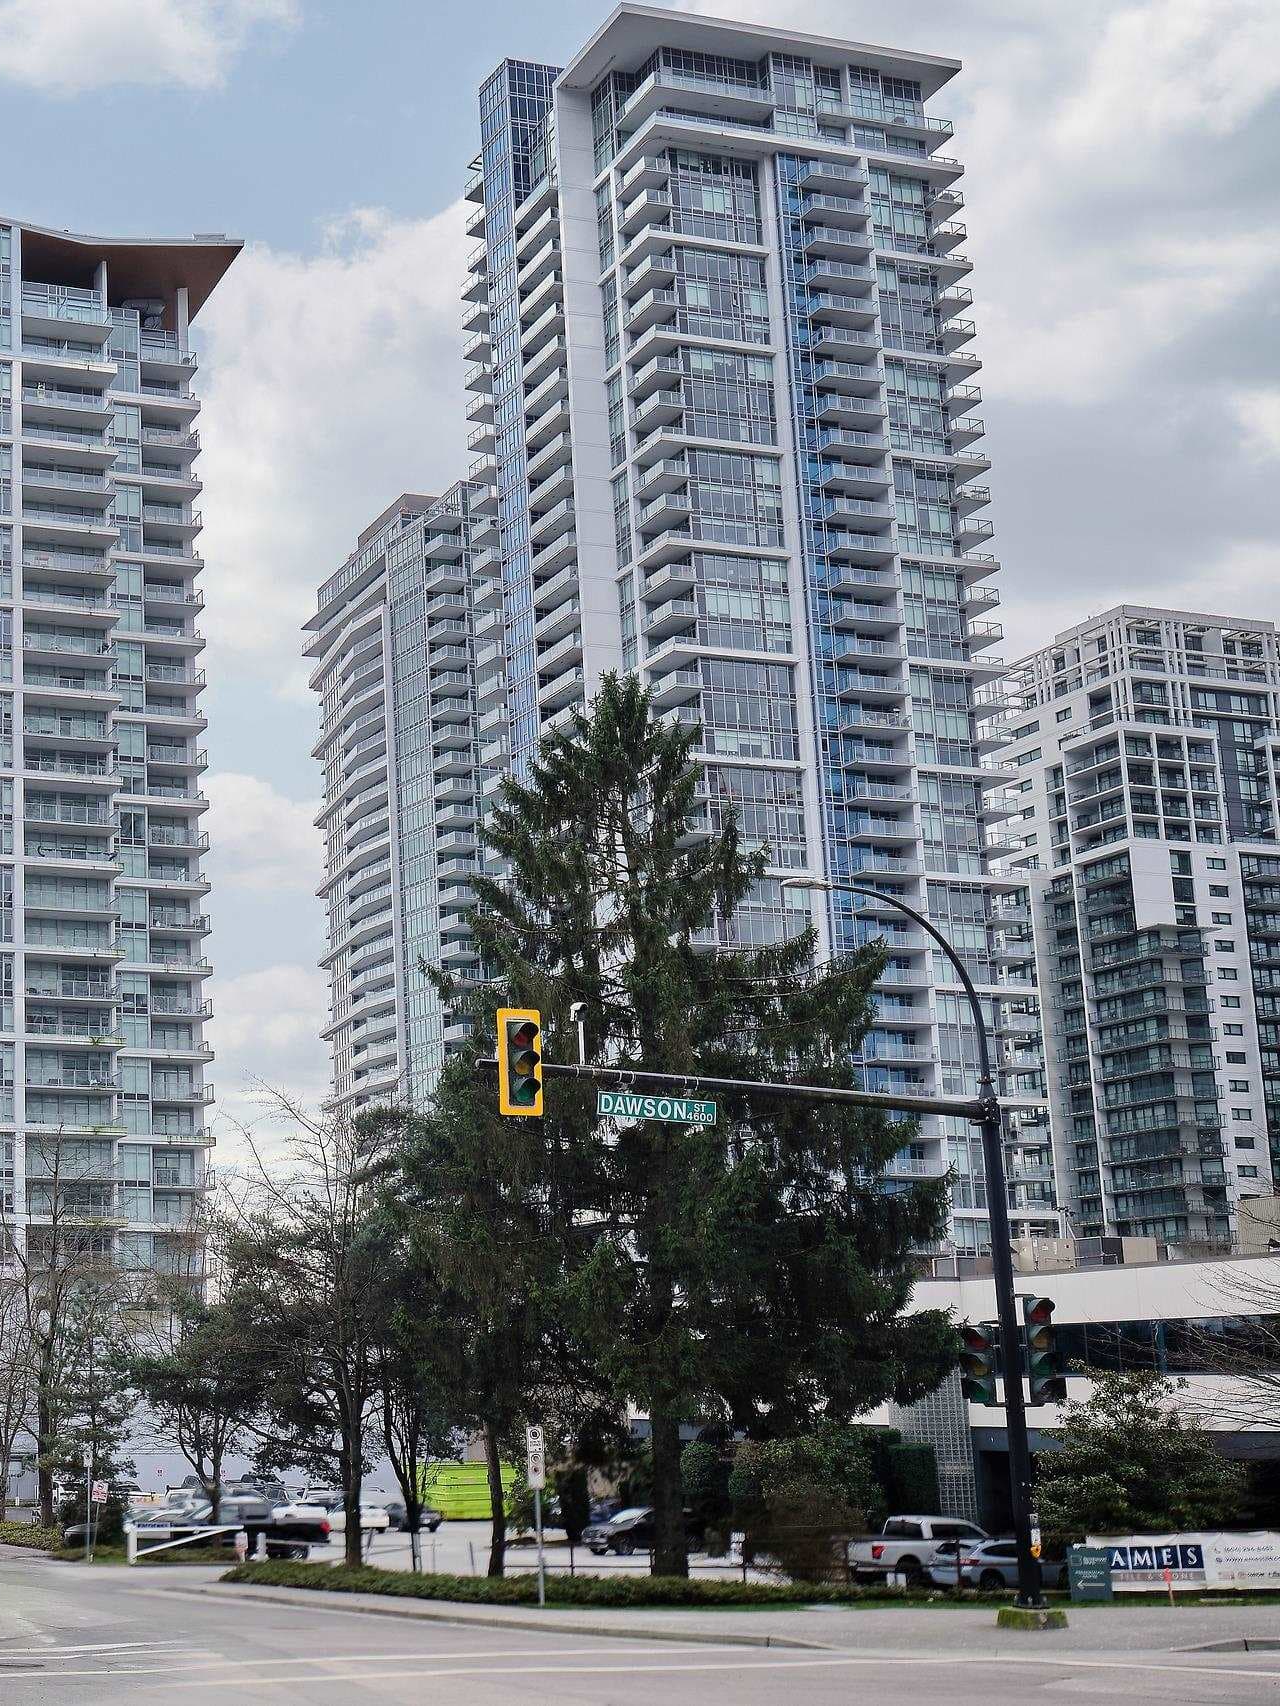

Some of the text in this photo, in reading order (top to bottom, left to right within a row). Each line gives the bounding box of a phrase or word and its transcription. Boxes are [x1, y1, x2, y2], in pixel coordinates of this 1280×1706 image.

[601, 1095, 706, 1119] DAWSON ST
[687, 1112, 713, 1122] 4600
[1111, 1547, 1197, 1566] AMES
[1159, 1572, 1194, 1581] SONE
